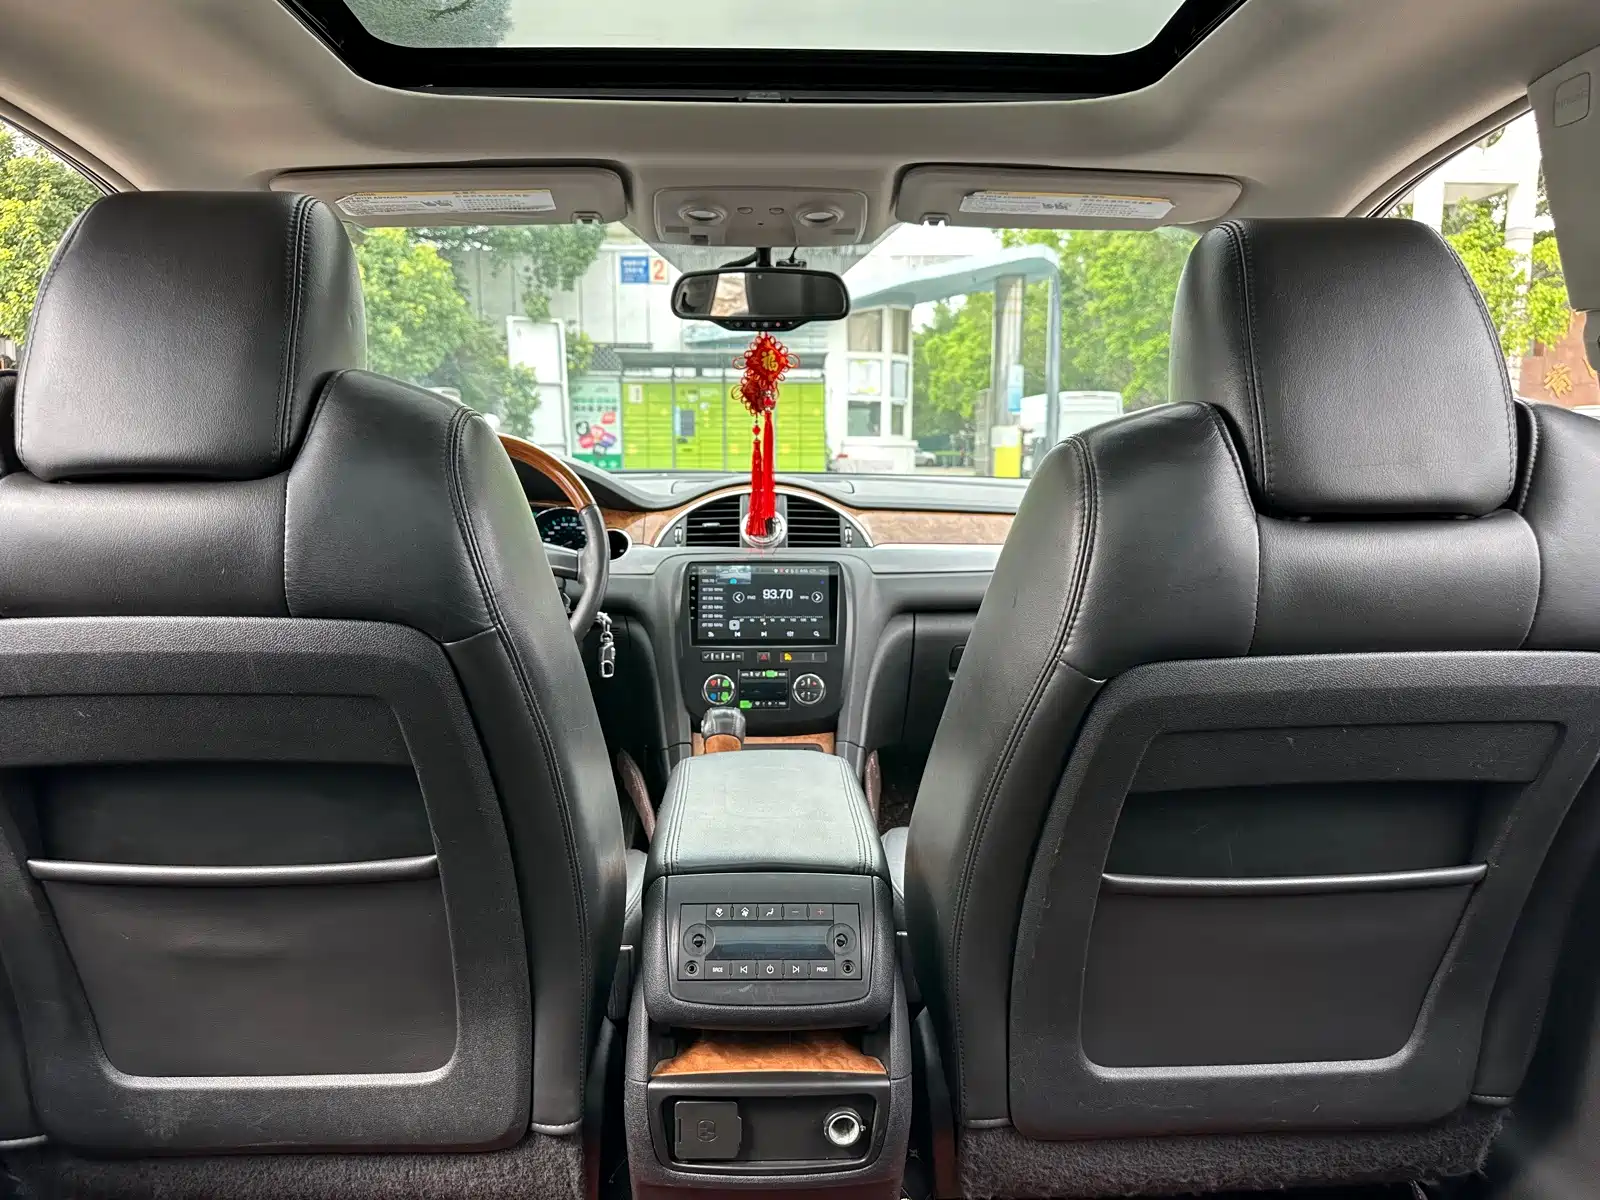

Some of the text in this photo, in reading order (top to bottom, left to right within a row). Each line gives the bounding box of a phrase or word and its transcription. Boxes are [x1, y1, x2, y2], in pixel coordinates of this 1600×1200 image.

[653, 259, 665, 281] 2
[761, 350, 779, 371] 福
[762, 588, 794, 600] 93.70
